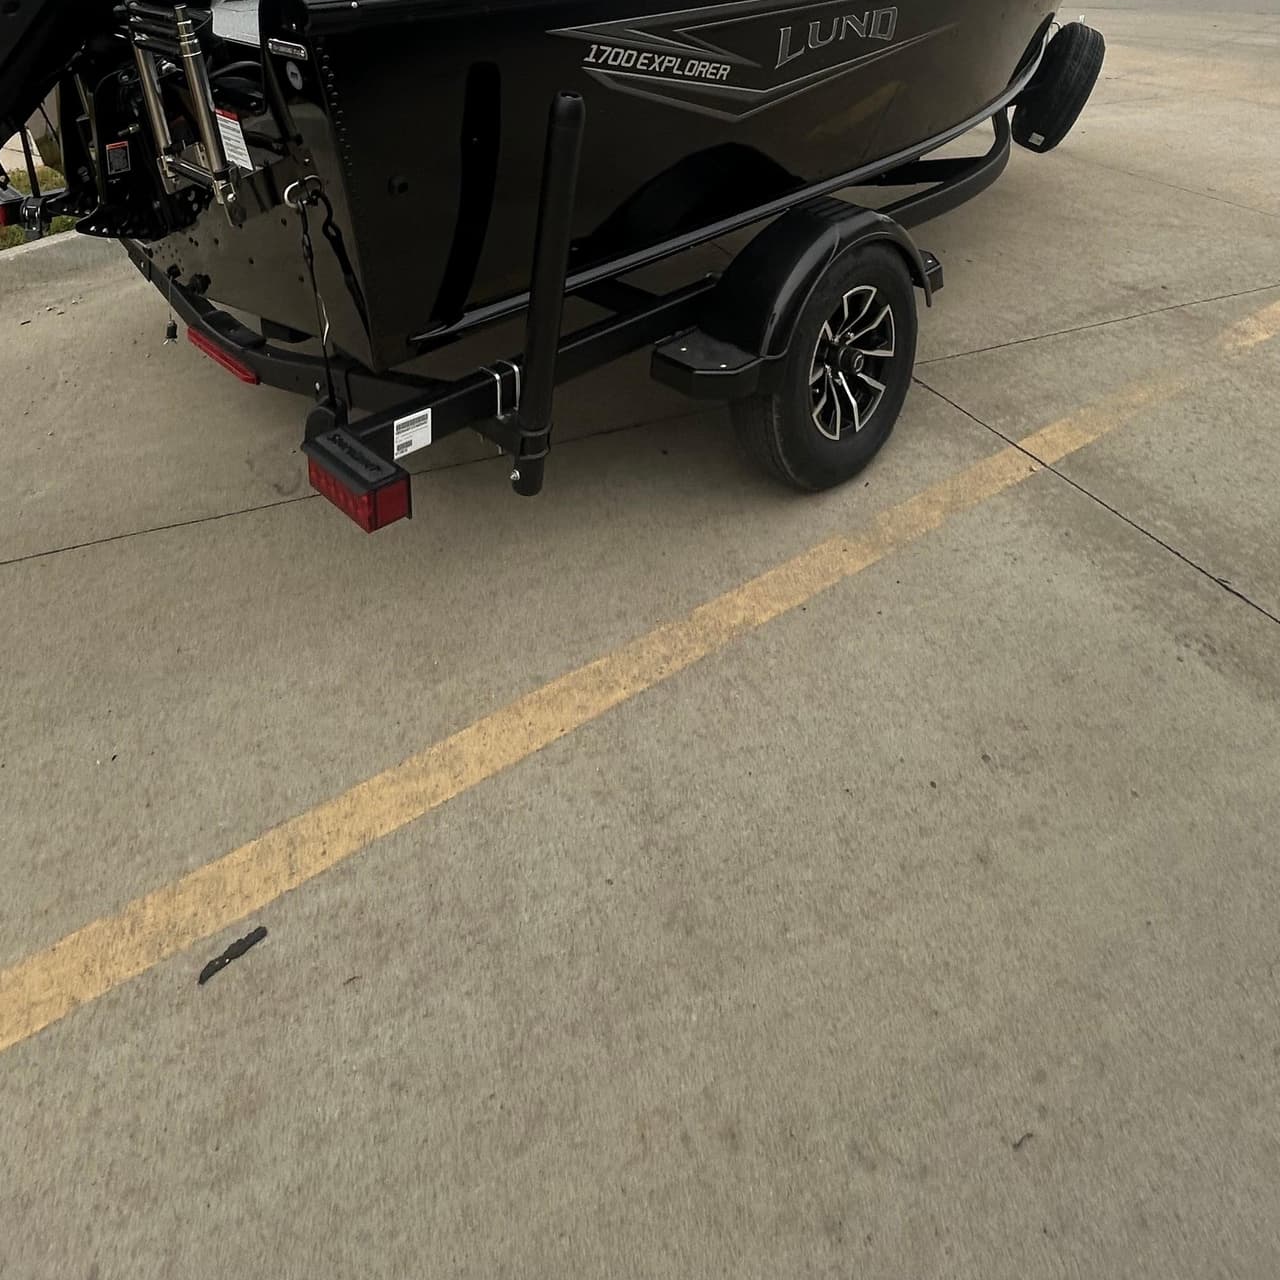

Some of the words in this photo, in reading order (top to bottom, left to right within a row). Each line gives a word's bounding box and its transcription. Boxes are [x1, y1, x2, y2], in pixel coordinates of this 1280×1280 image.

[583, 43, 638, 68] 1700
[636, 51, 731, 81] EXPLORER
[774, 6, 899, 70] LUND
